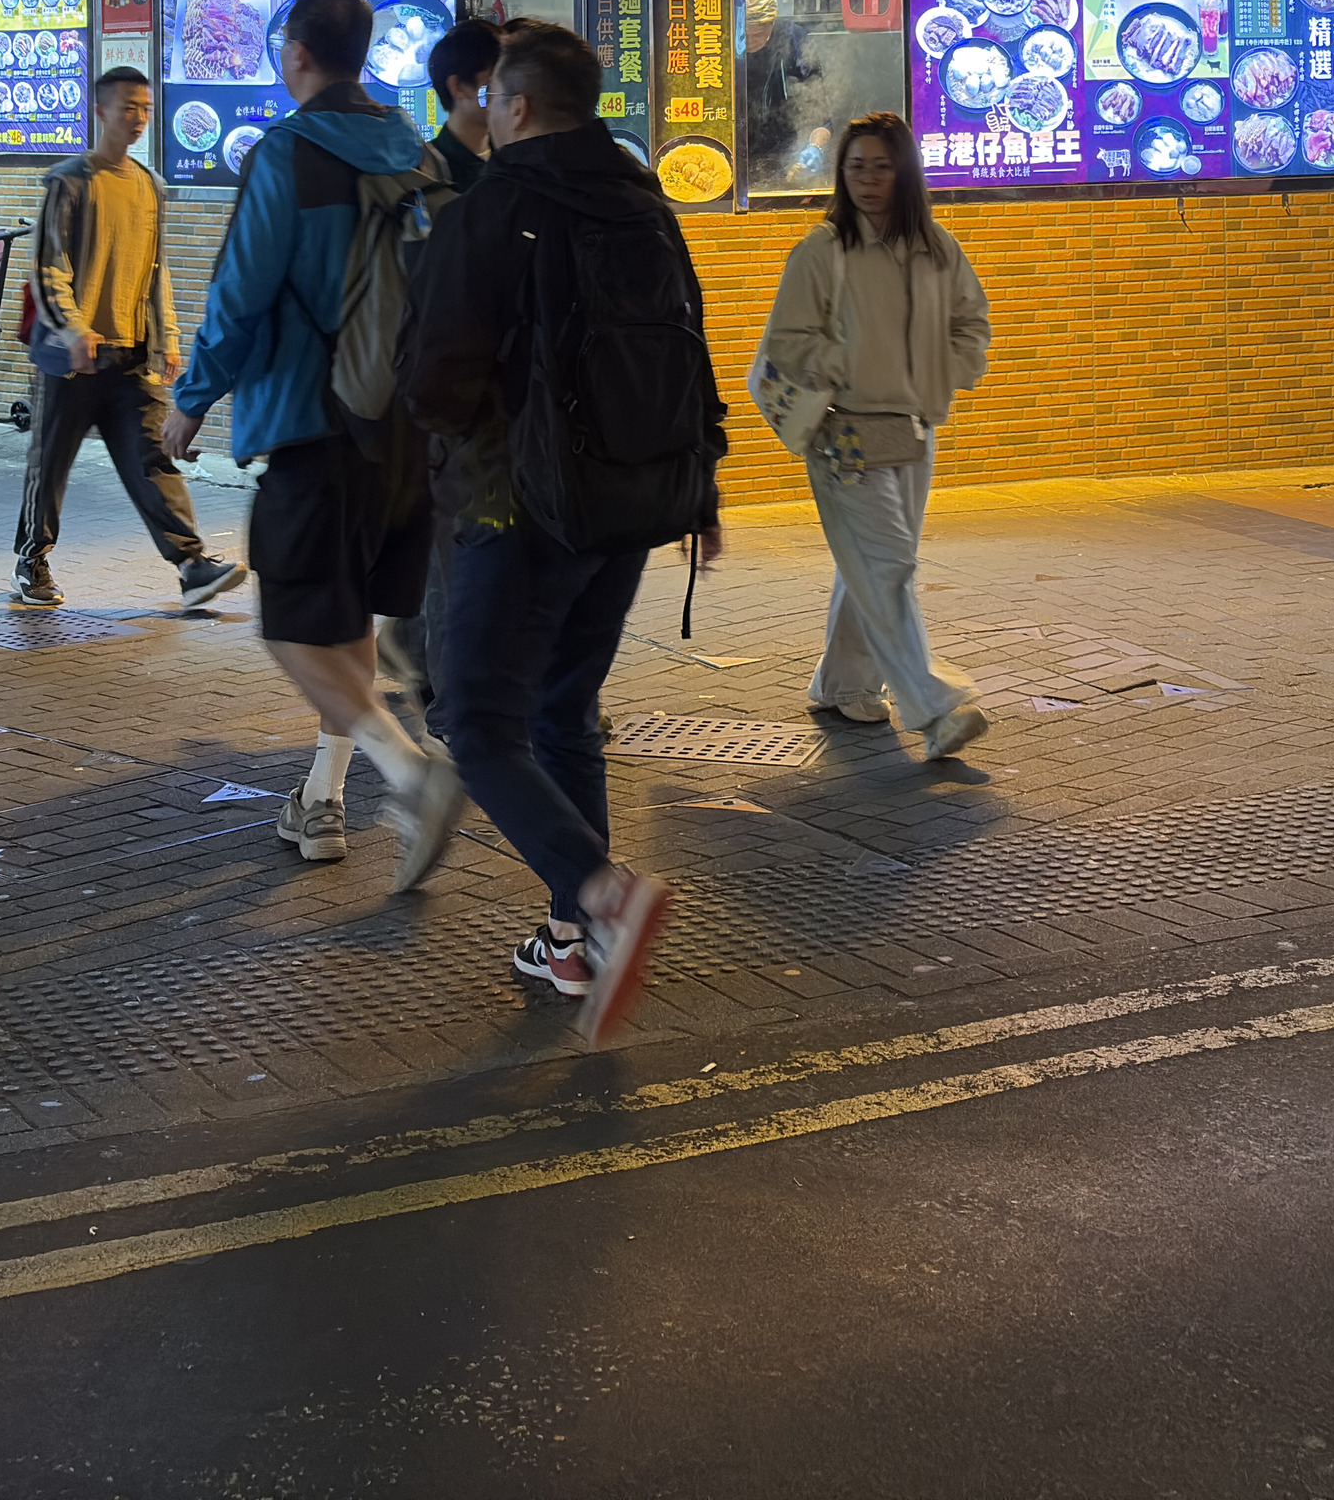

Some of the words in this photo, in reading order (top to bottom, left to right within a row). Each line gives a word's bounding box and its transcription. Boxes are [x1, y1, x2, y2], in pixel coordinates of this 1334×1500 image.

[920, 129, 1083, 169] 香港仔魚蛋王
